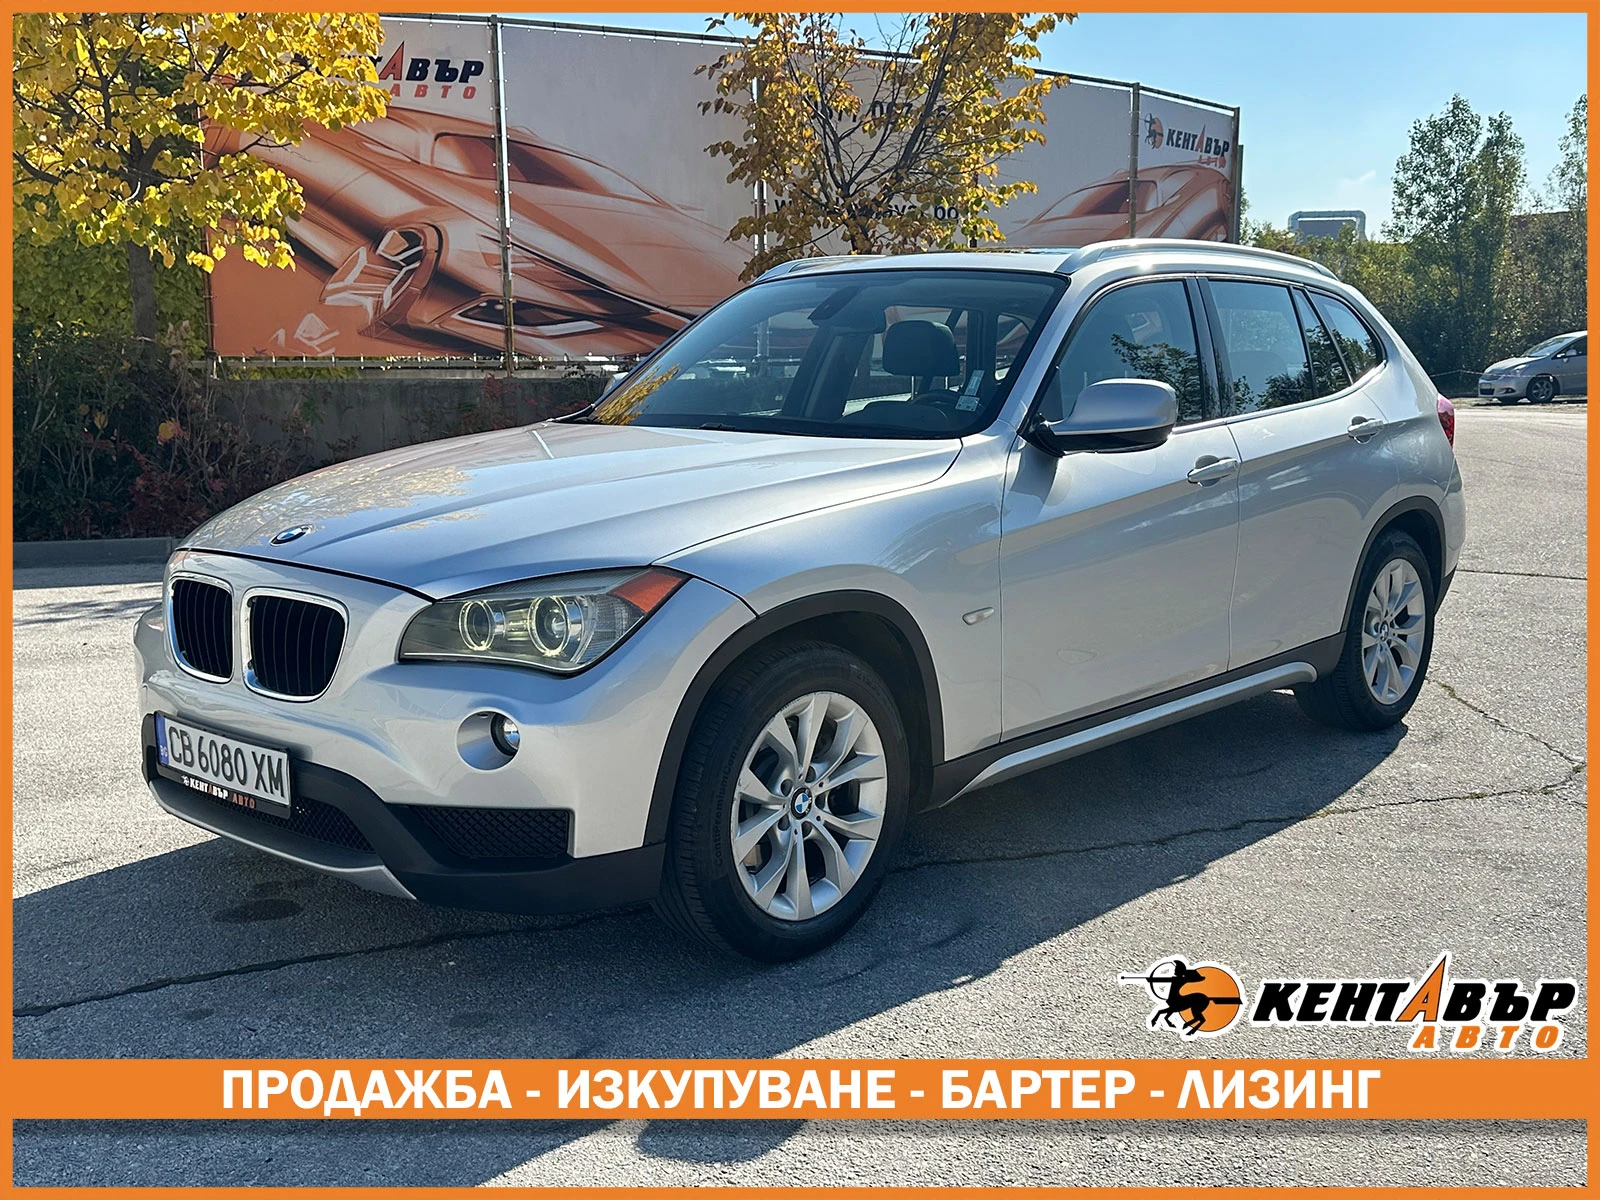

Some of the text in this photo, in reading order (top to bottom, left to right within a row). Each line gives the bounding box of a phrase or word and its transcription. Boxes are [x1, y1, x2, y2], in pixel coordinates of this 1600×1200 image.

[389, 84, 477, 99] АВТО
[1166, 123, 1230, 157] КЕНТАВЪР
[198, 735, 247, 786] 6080
[189, 778, 256, 808] КЕНТАВЪР АВТО
